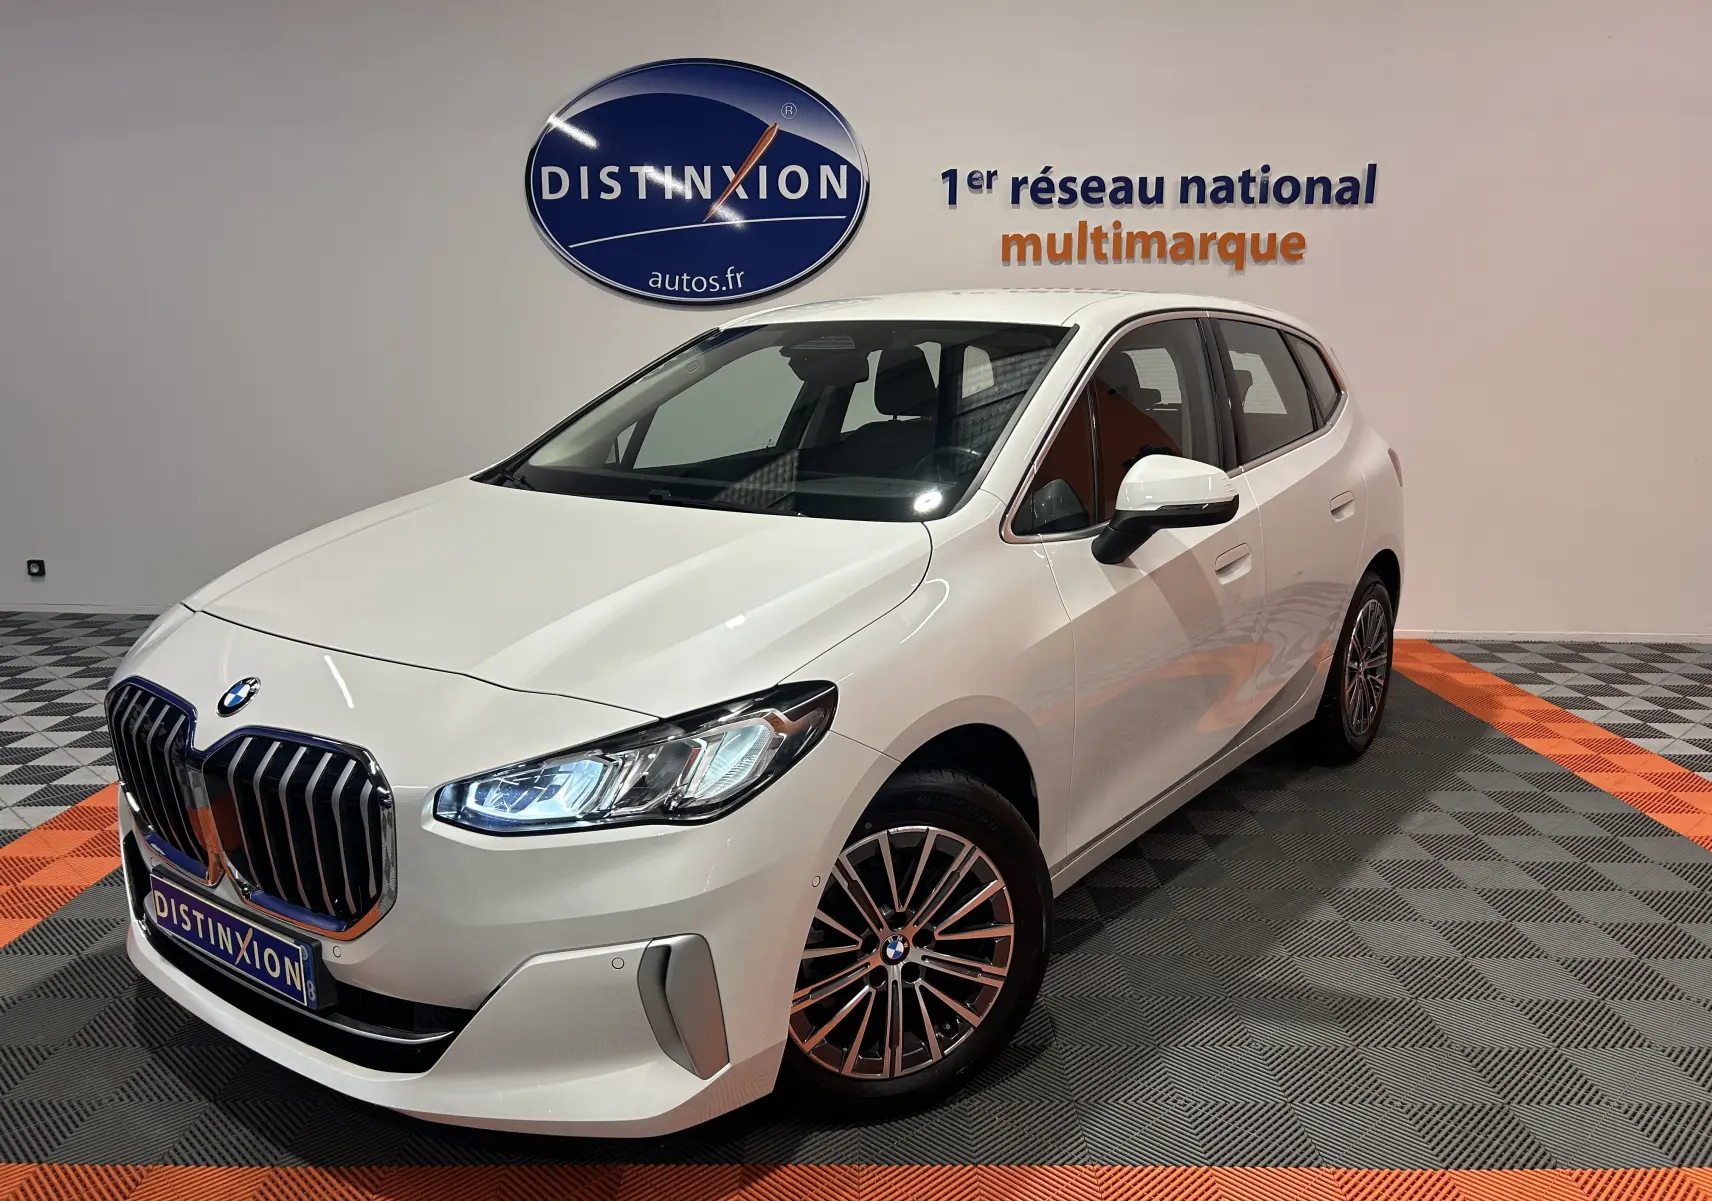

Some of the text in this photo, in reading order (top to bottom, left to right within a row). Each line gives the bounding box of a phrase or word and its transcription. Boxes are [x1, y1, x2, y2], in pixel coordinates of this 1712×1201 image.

[540, 164, 848, 201] DISTINXION
[940, 163, 1379, 207] 1er réseau national
[1000, 219, 1307, 272] multimarque
[648, 266, 744, 293] autos.fr
[153, 888, 303, 992] DISTINXION
